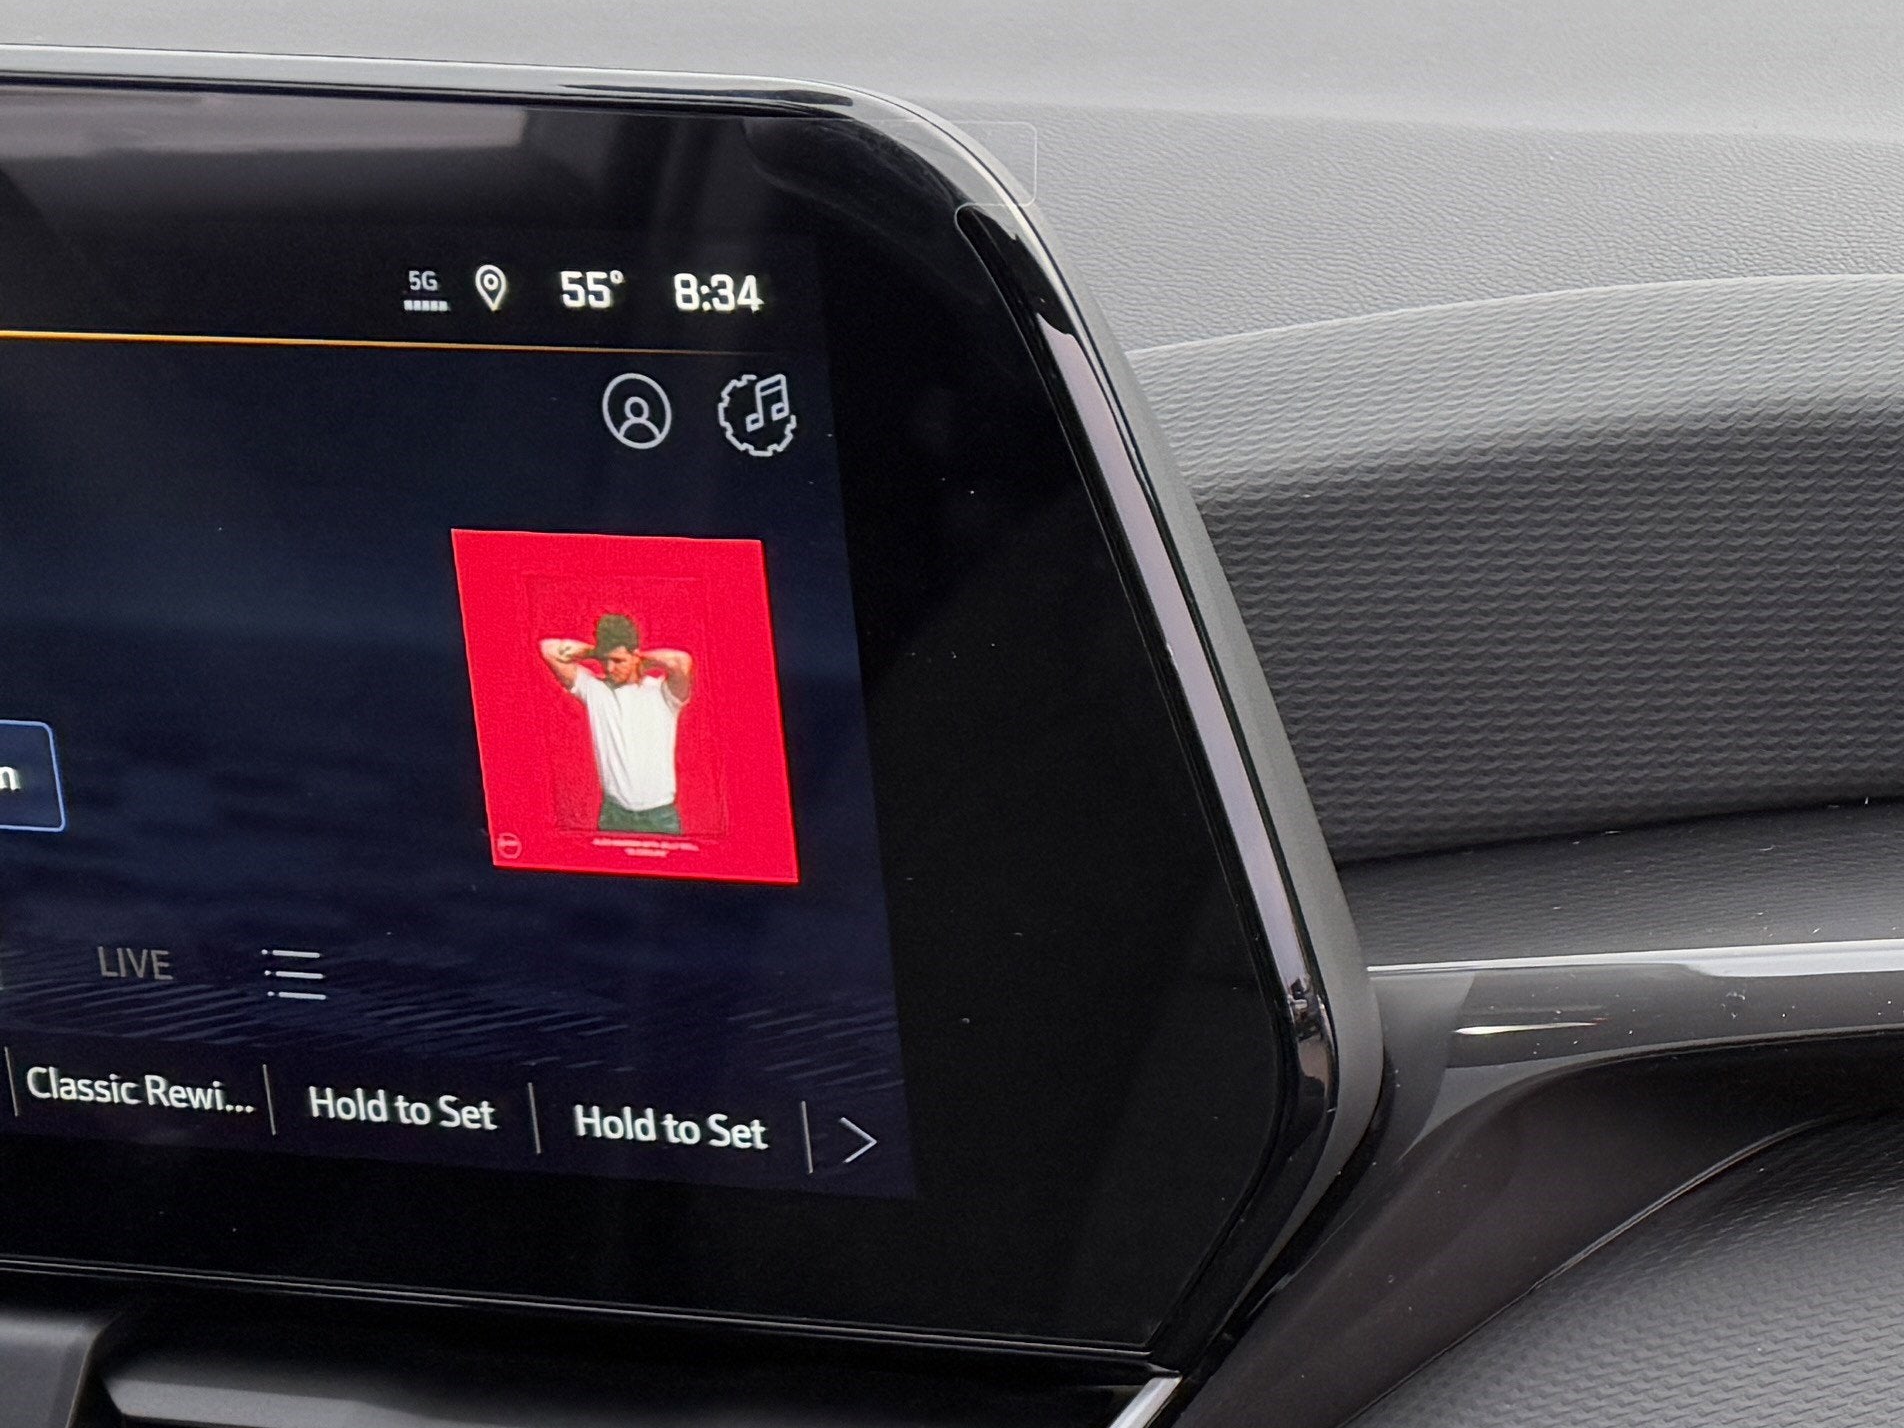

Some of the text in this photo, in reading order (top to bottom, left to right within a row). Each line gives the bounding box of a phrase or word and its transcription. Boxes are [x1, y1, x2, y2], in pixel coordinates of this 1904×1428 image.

[408, 270, 439, 292] 5G
[560, 269, 625, 310] 55°
[673, 272, 765, 314] 8:34
[97, 946, 173, 981] LIVE
[26, 1066, 256, 1114] Classic Rewi...
[308, 1085, 498, 1132] Hold to Set
[574, 1103, 769, 1151] Hold to Set
